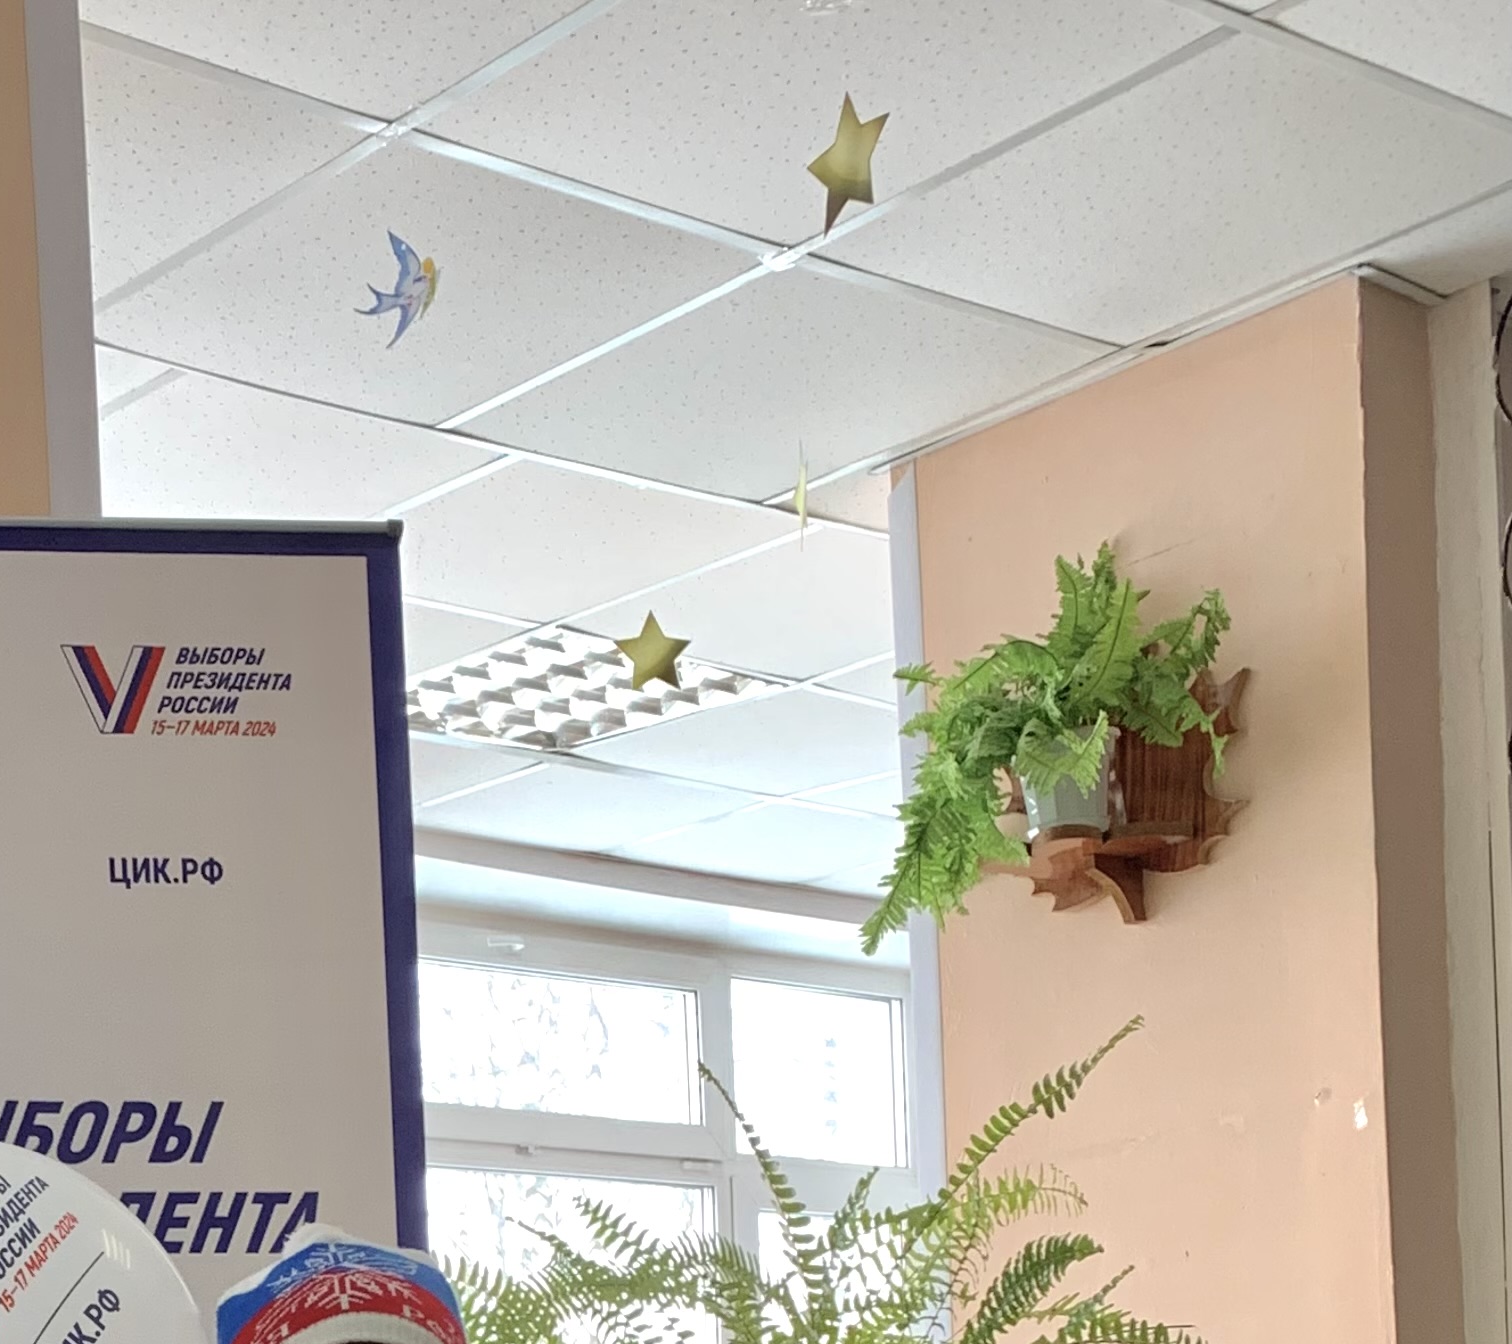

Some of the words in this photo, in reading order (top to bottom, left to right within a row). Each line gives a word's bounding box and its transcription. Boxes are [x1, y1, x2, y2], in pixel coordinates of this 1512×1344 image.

[175, 647, 266, 666] ВЫБОРЫ
[166, 672, 292, 692] ПРЕЗИДЕНТА
[157, 696, 239, 714] РОССИИ
[191, 720, 240, 737] МАРТА
[241, 721, 277, 737] 2024
[108, 856, 223, 889] ЦИК.РФ
[26, 1234, 60, 1279] МАРТА
[54, 1211, 80, 1241] 2024
